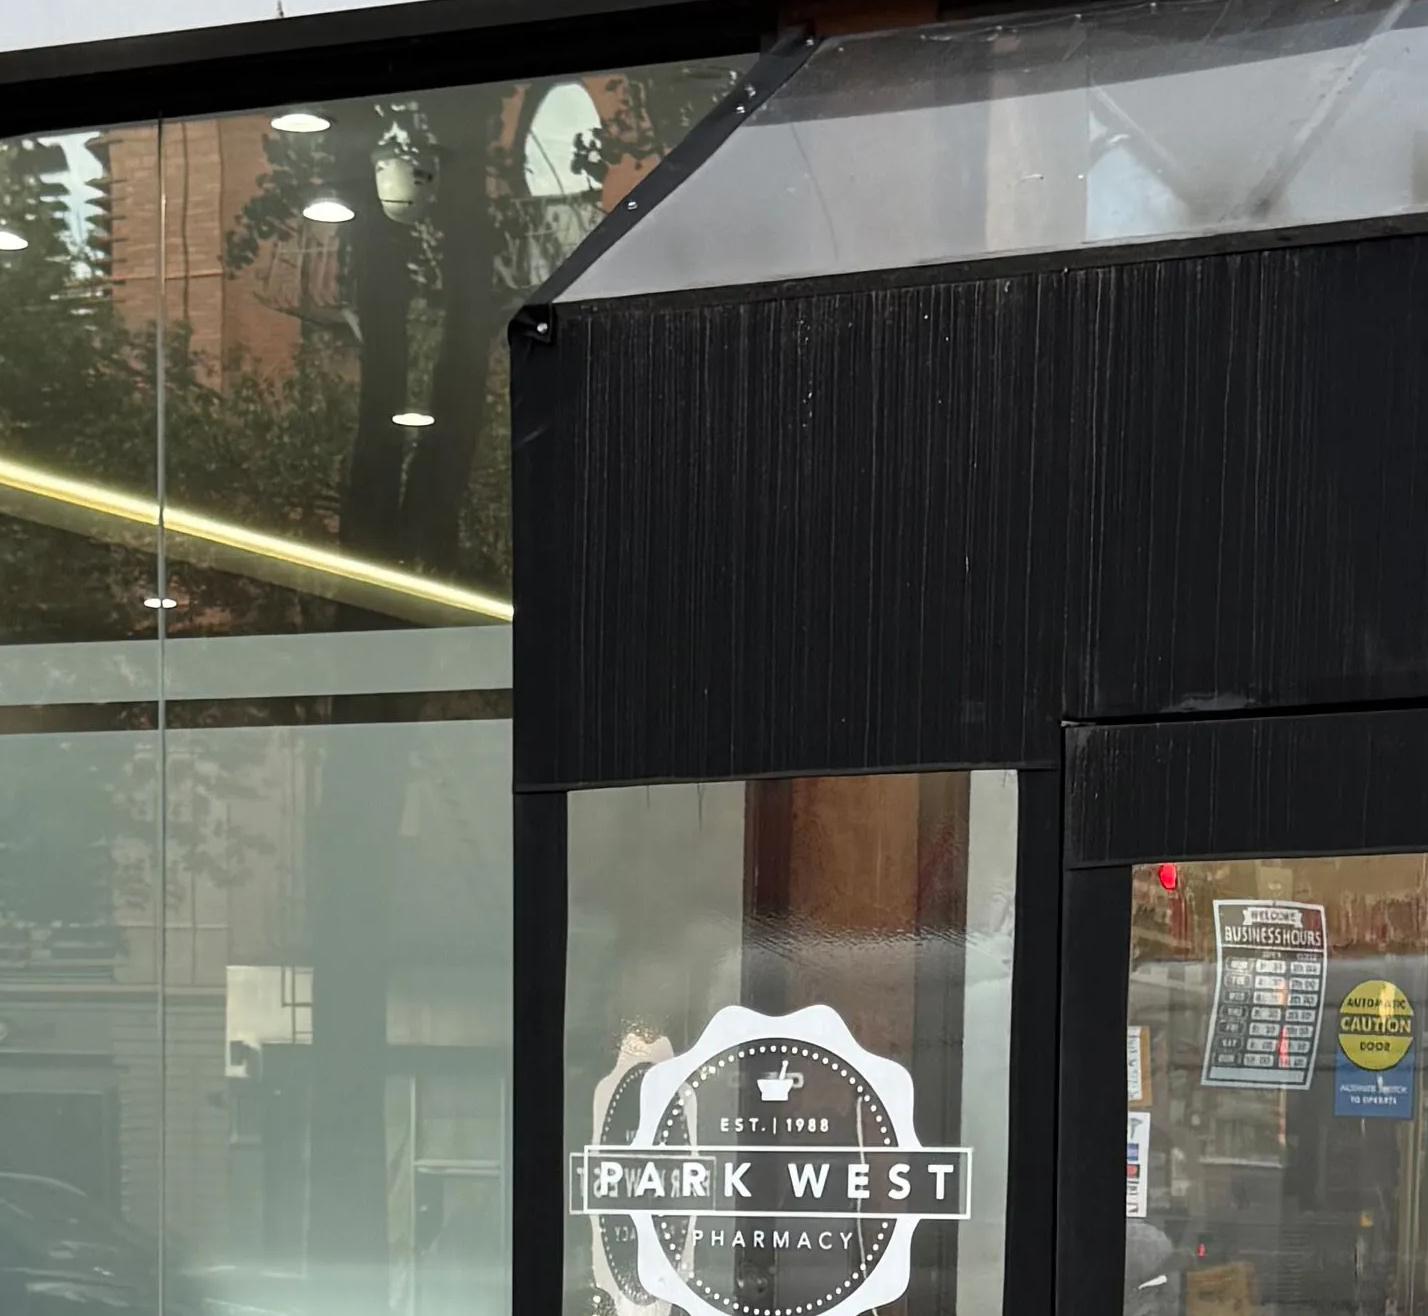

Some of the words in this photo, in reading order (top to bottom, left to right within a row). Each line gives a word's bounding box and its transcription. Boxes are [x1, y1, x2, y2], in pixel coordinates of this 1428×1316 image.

[1224, 925, 1281, 944] BUSINESS
[1282, 928, 1322, 947] HOURS
[1340, 1016, 1412, 1034] CAUTION
[1359, 1041, 1391, 1052] DOOR
[720, 1117, 765, 1133] EST.
[785, 1117, 830, 1133] 1988
[600, 1161, 752, 1198] PARK
[787, 1164, 954, 1200] WEST
[692, 1228, 853, 1250] PHARMACY
